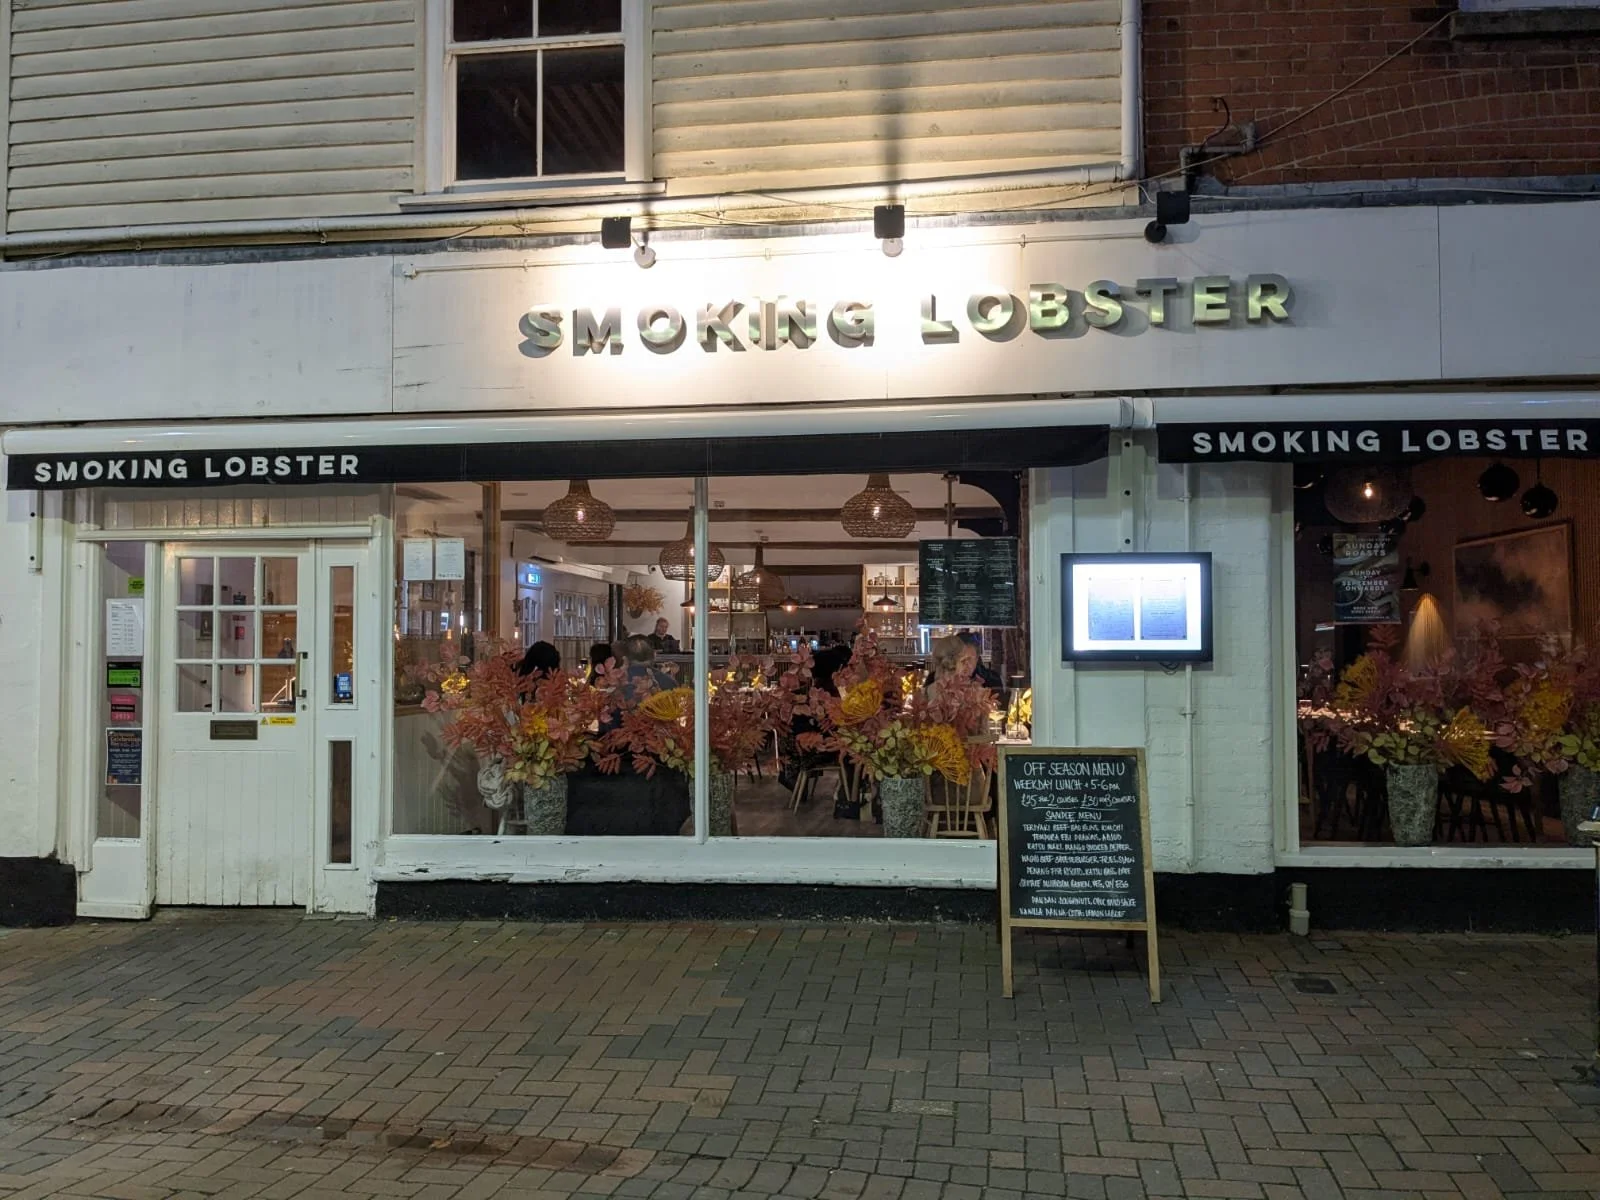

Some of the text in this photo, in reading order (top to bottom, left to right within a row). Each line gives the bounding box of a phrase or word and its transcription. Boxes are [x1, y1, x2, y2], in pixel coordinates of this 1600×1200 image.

[520, 272, 1292, 356] SMOKING LOBSTER
[1193, 428, 1589, 454] SMOKING LOBSTER
[34, 454, 360, 483] SMOKING LOBSTER
[1023, 762, 1126, 777] OFF SEASON MENU
[1013, 778, 1053, 791] WEEKDAY
[1055, 779, 1082, 791] LUNCH
[1078, 811, 1102, 821] MENU
[1022, 824, 1051, 832] TERIYAKI
